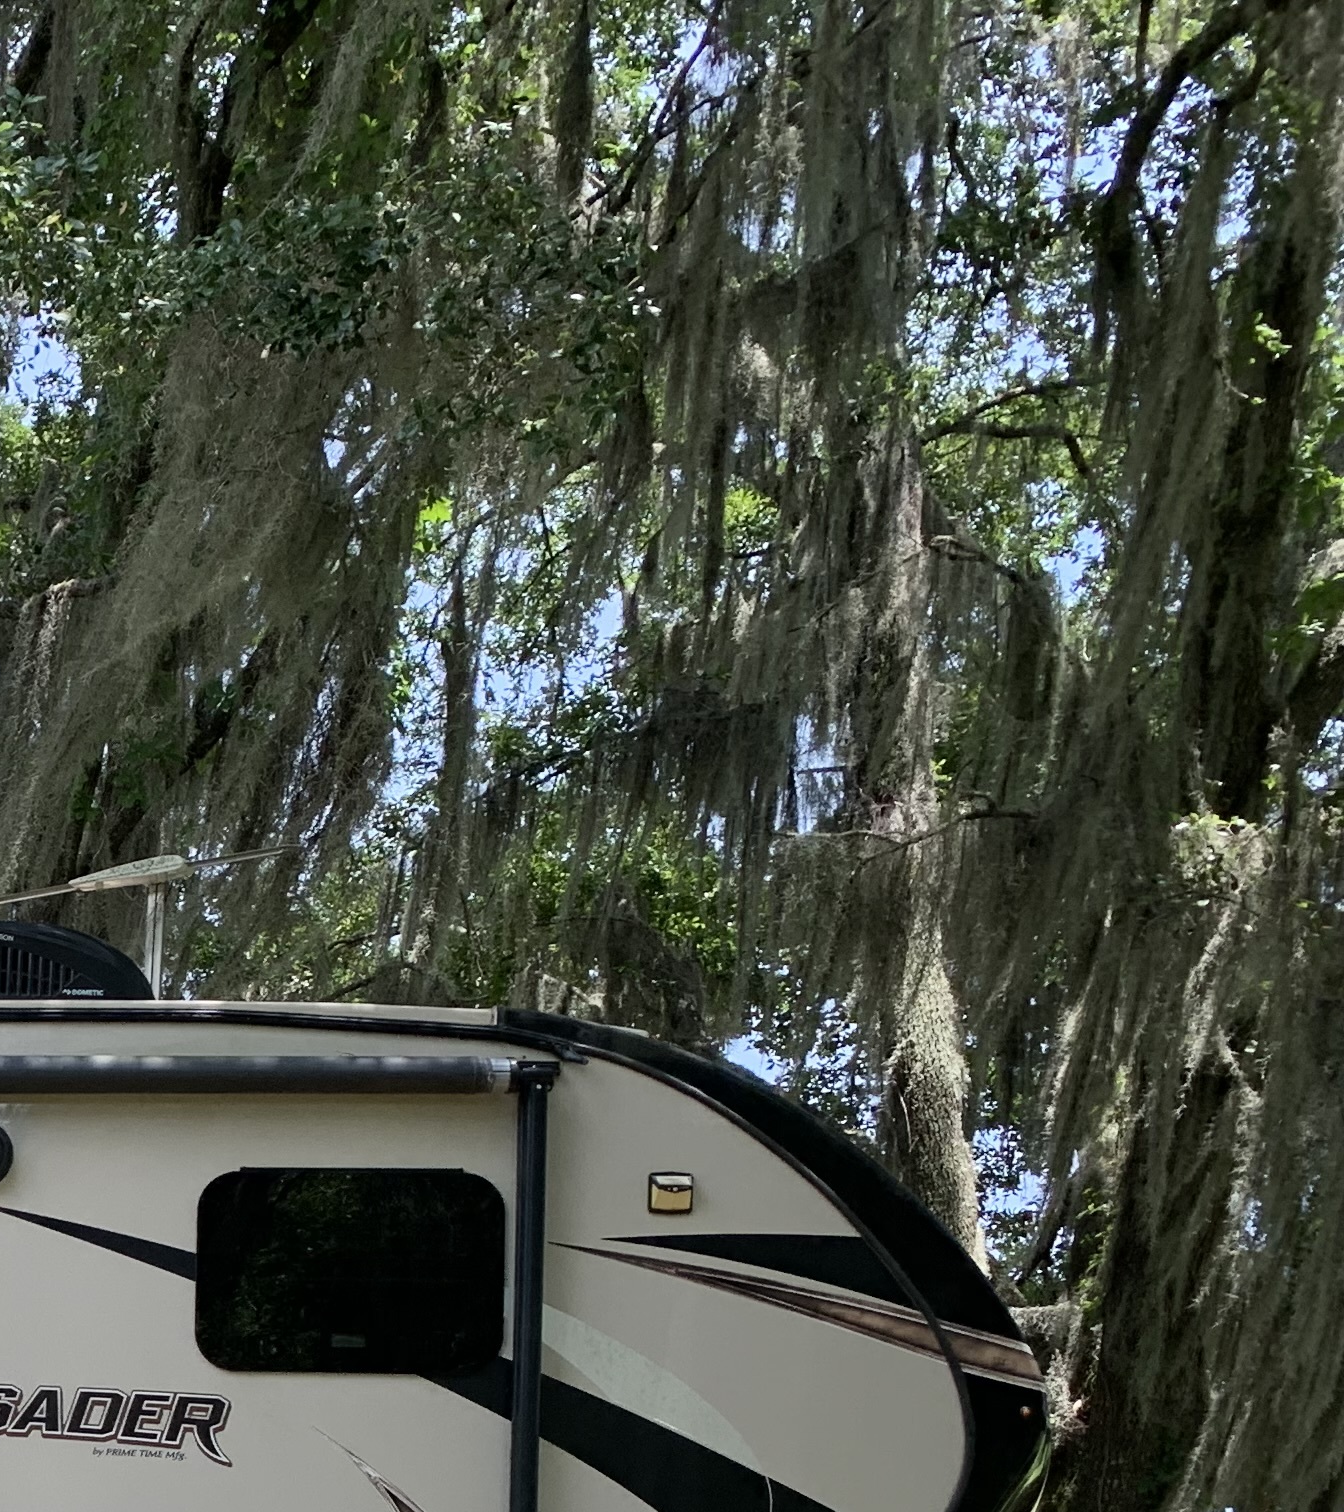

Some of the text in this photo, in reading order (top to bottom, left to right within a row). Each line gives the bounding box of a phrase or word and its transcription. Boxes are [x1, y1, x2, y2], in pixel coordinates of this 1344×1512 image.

[92, 1447, 104, 1457] by
[106, 1448, 137, 1457] PRIME
[139, 1449, 163, 1458] TIME
